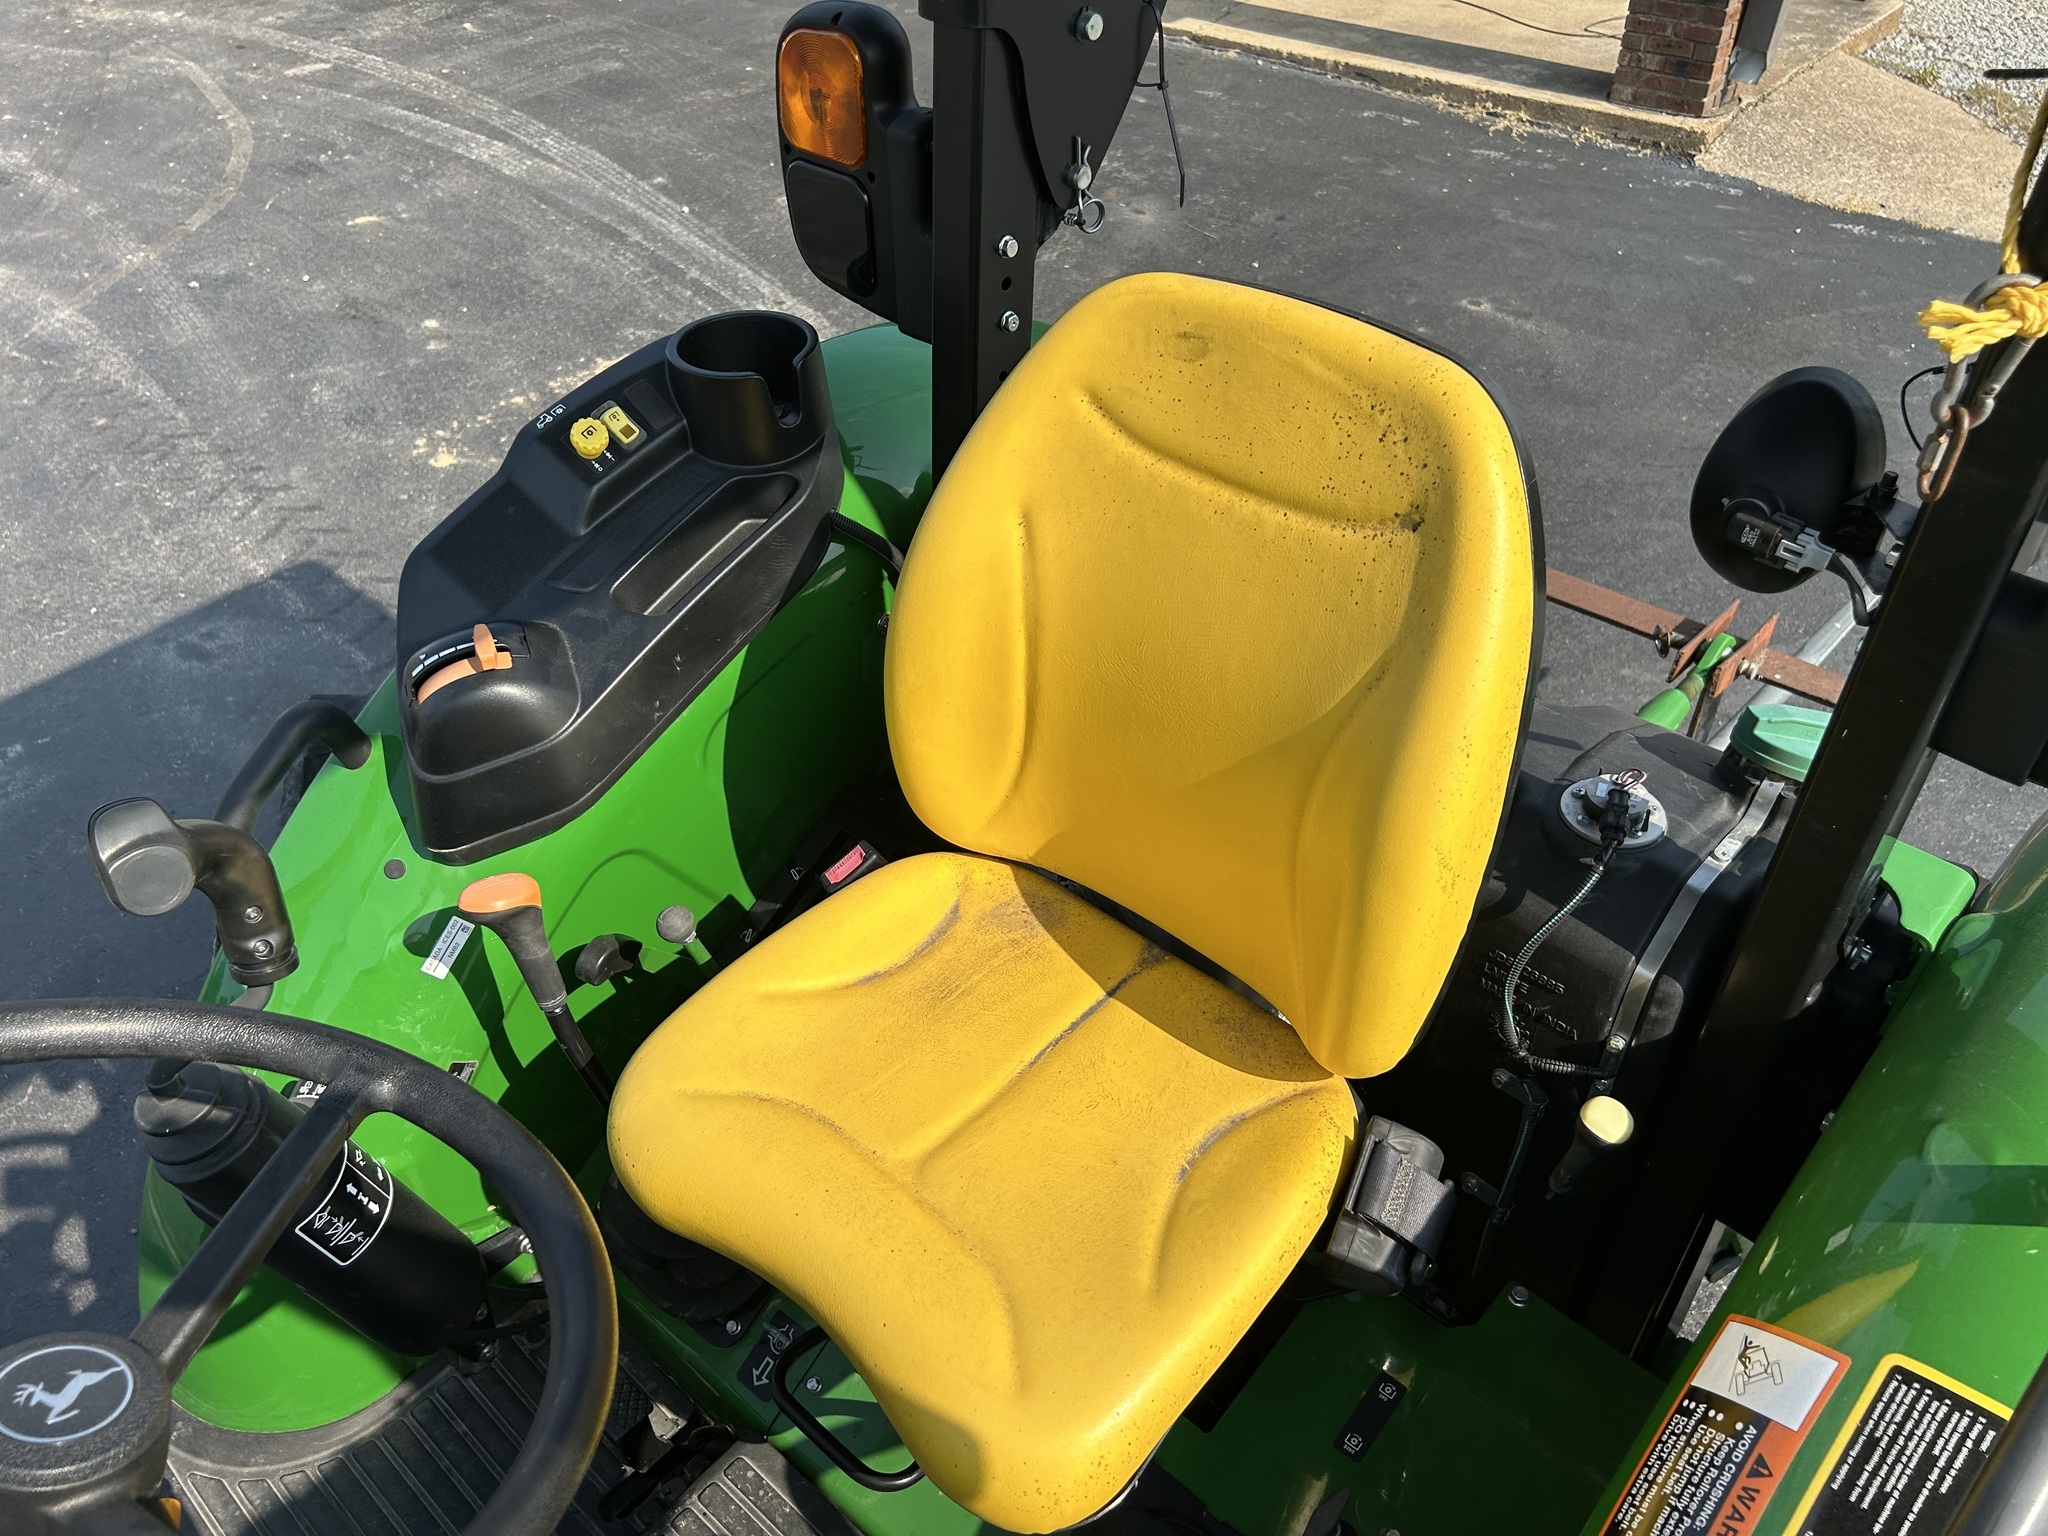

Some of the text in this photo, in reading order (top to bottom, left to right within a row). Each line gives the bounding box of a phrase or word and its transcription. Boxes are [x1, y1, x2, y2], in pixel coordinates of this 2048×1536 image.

[1523, 1002, 1537, 1017] IN
[1543, 1013, 1578, 1040] INDIA
[1903, 1388, 1917, 1405] Keep
[1915, 1394, 1929, 1411] Keep
[1661, 1413, 1681, 1441] Drive
[1674, 1416, 1688, 1434] DO
[1701, 1427, 1716, 1444] Do
[1968, 1422, 1983, 1440] Keep
[1647, 1443, 1663, 1466] with
[1660, 1435, 1677, 1460] NOT
[1660, 1424, 1707, 1495] Use seat belt.
[1689, 1445, 1704, 1465] not
[1691, 1432, 1725, 1483] Structure
[1713, 1436, 1736, 1466] Keep
[1630, 1403, 1707, 1529] When structure must be
[1647, 1460, 1661, 1480] use
[1670, 1463, 1694, 1494] jump
[1693, 1424, 1757, 1530] AVOID CRUSHING:
[1630, 1467, 1649, 1494] extra
[1632, 1481, 1649, 1506] seat
[1687, 1467, 1718, 1515] Rollover
[1614, 1495, 1632, 1522] care.
[1674, 1484, 1696, 1511] fully
[1618, 1506, 1637, 1530] belt.
